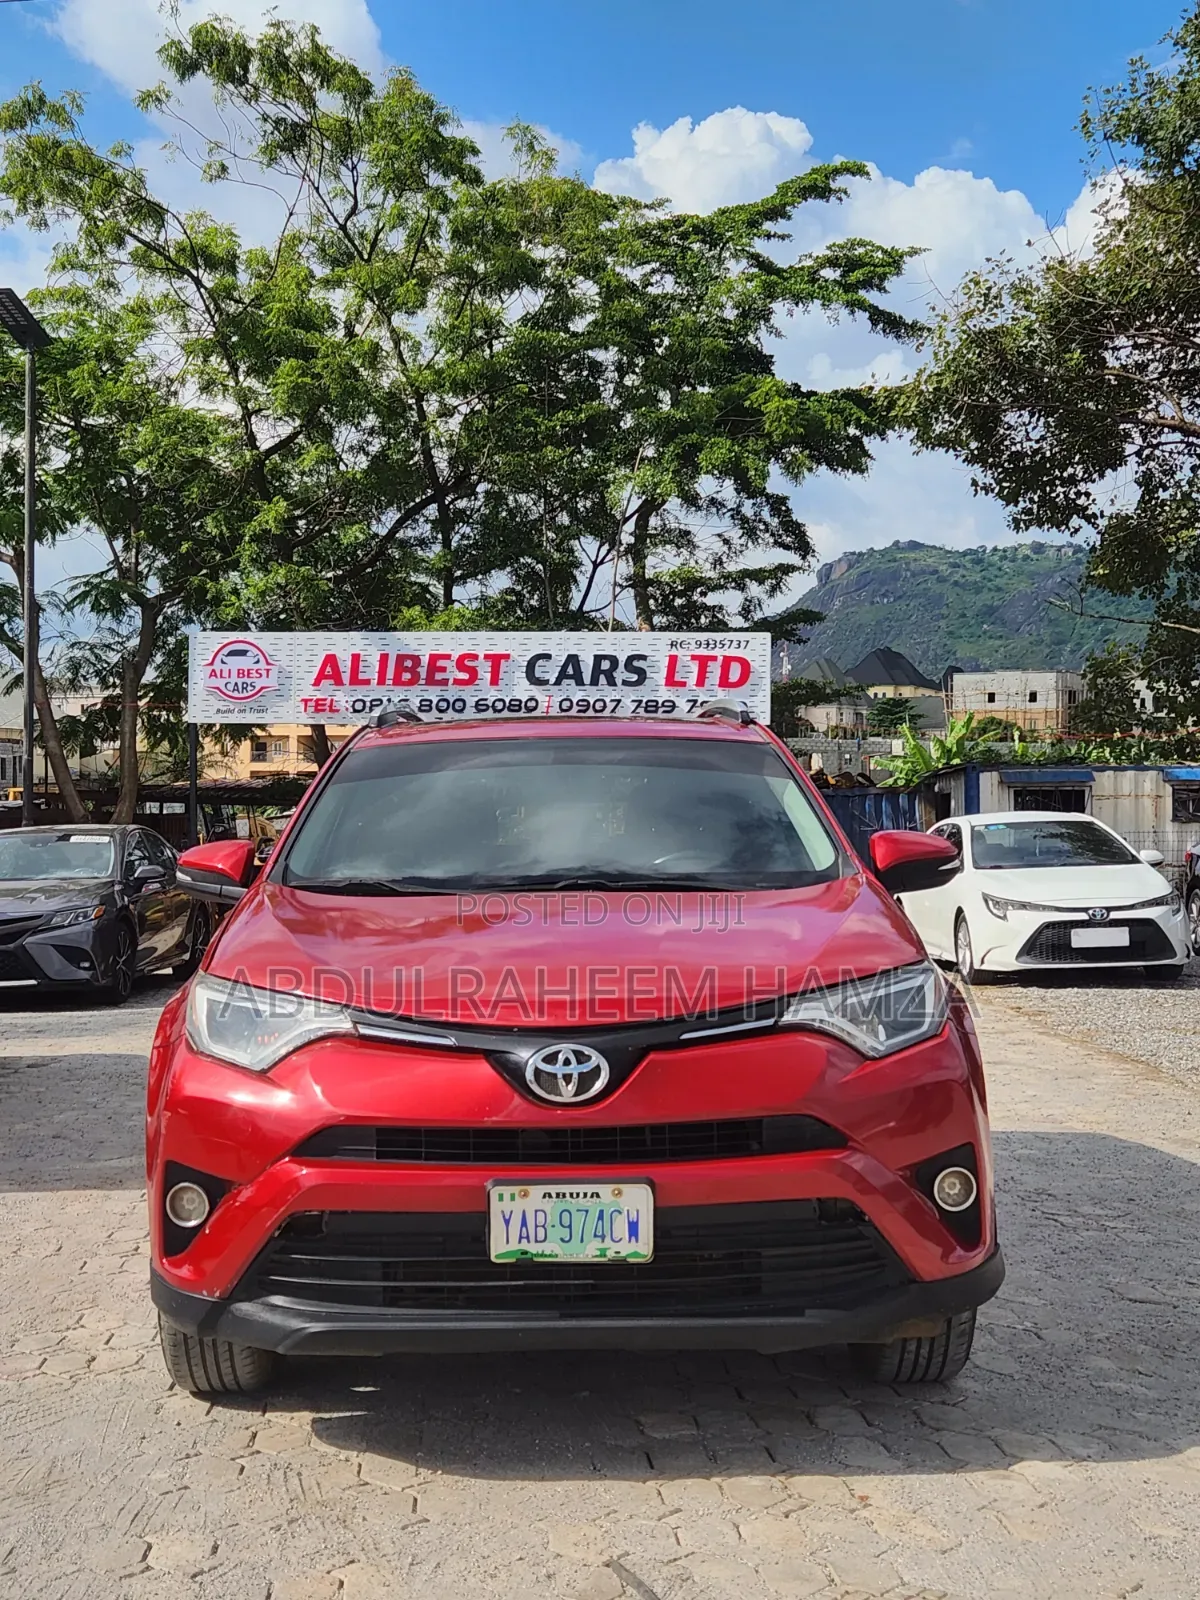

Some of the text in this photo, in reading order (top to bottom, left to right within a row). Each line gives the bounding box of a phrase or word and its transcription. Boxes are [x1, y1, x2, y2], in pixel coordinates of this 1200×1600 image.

[694, 639, 750, 650] 9335737
[208, 668, 272, 679] ALI BEST
[311, 652, 752, 689] ALIBEST CARS LTD
[224, 681, 257, 694] CARS
[215, 707, 235, 715] Build
[418, 698, 467, 713] 800
[475, 698, 539, 713] 6080
[558, 699, 621, 713] 0907
[631, 699, 676, 714] 789
[501, 1209, 640, 1245] YAB-974CW
